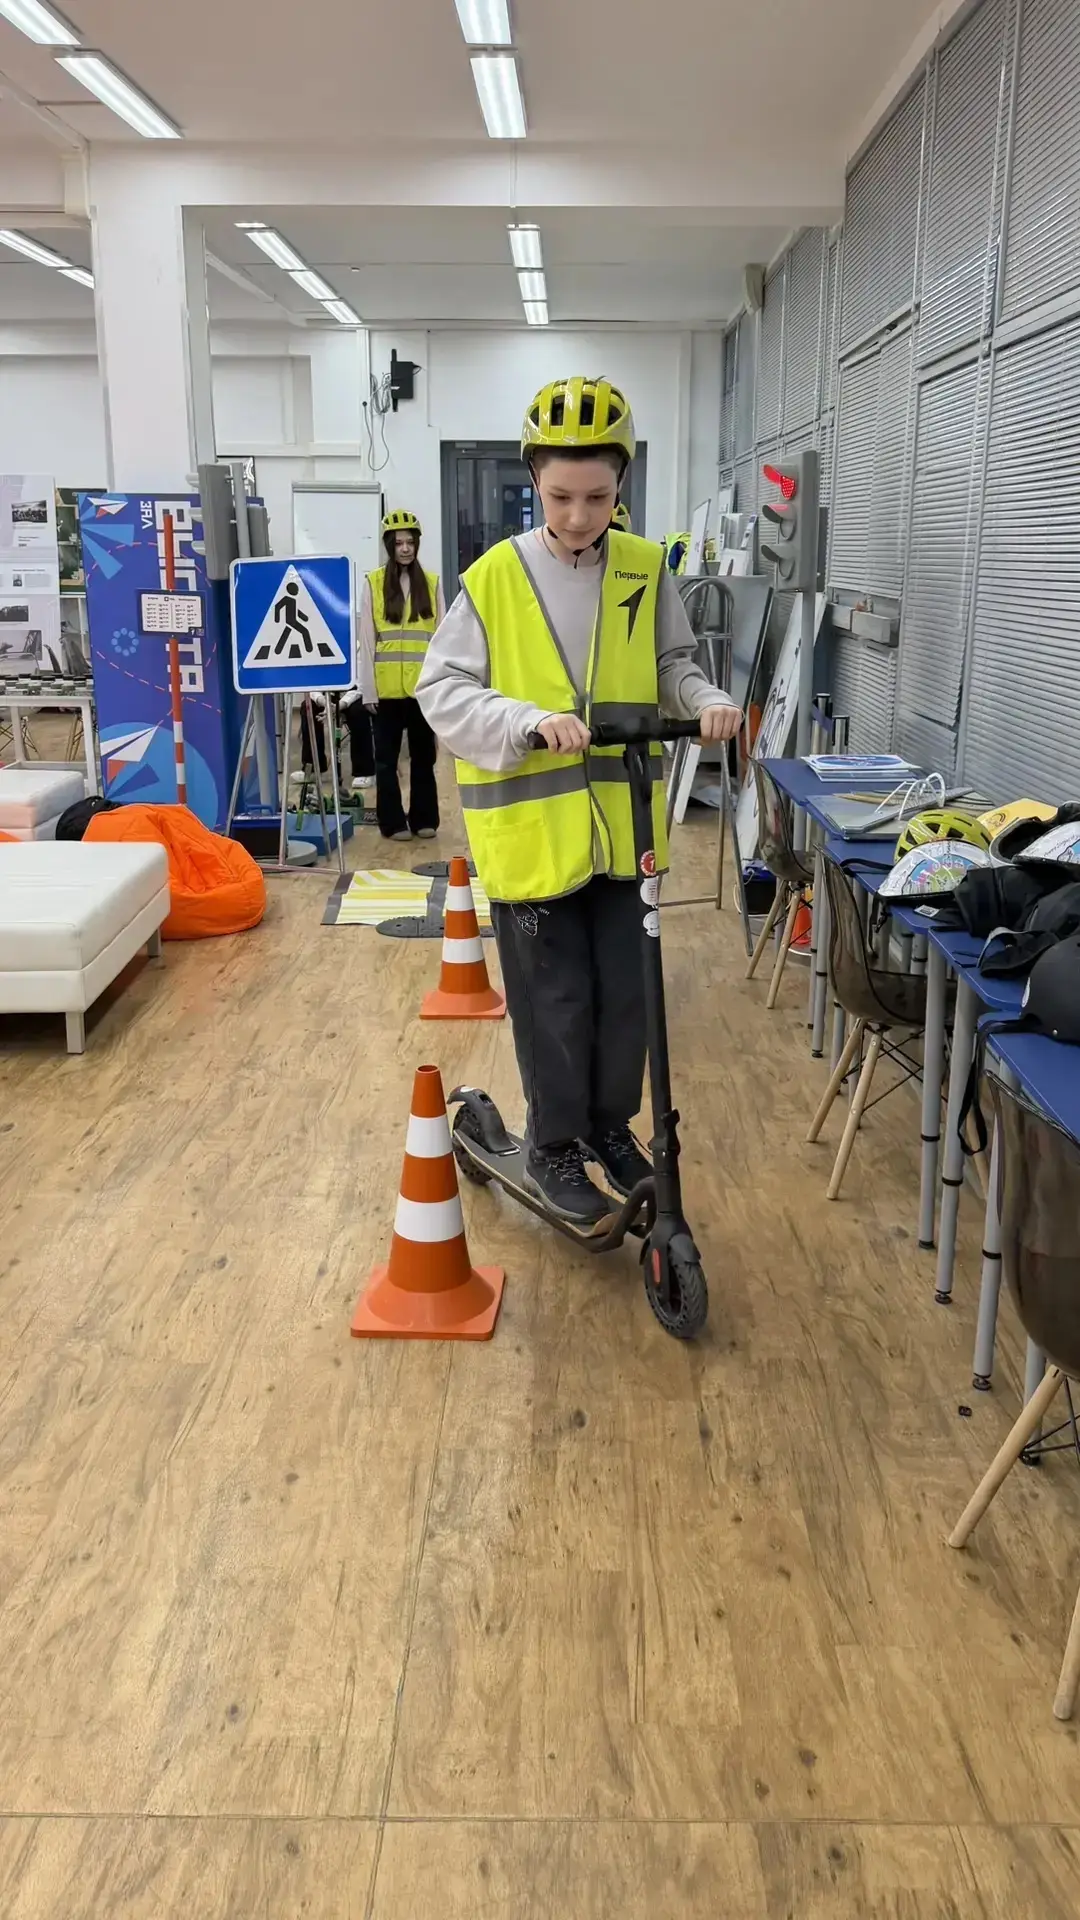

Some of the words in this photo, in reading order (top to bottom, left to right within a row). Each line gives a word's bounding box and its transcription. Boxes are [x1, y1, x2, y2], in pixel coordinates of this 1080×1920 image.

[140, 500, 154, 530] ЗАЛ
[614, 570, 649, 581] Первые
[155, 501, 204, 693] ВЫСТА
